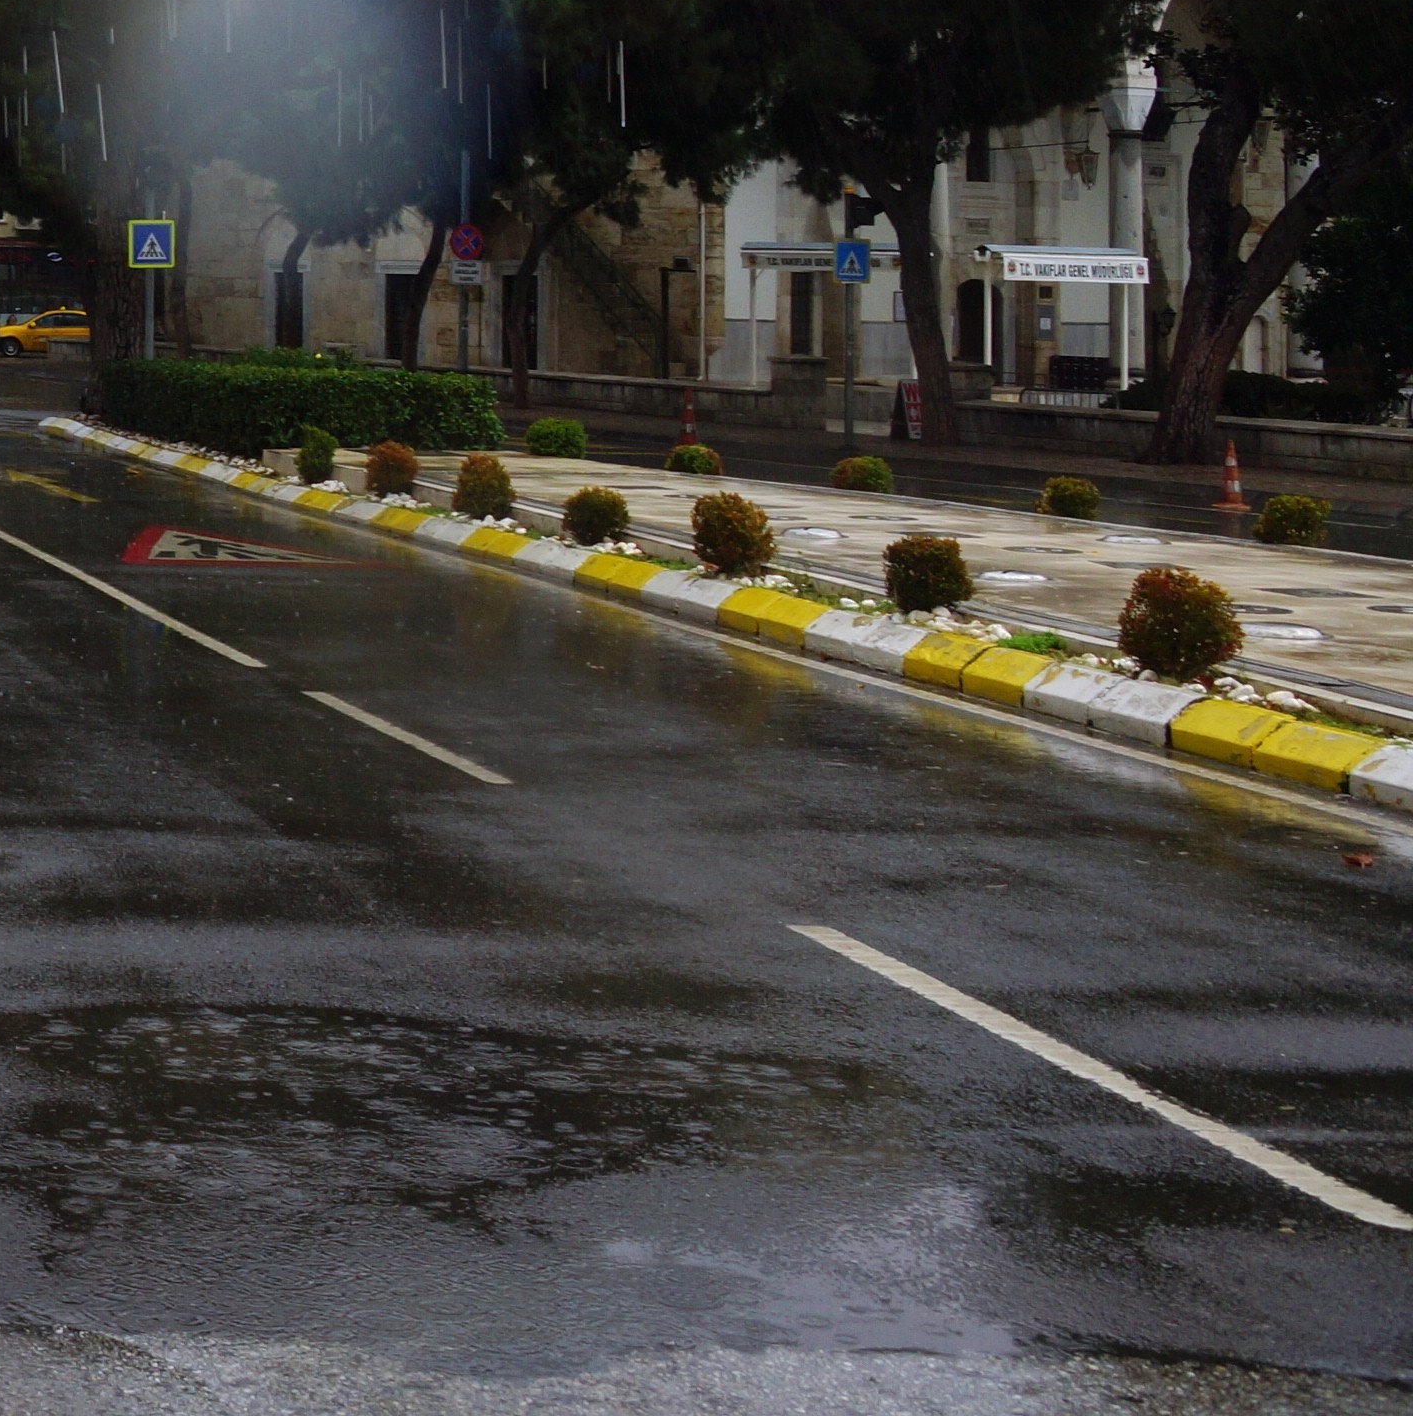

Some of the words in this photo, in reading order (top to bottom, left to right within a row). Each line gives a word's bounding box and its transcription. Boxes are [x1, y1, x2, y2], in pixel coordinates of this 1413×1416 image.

[814, 258, 833, 266] GENE
[1019, 263, 1032, 276] T.C.
[1034, 264, 1067, 277] VAKIFLAR
[1069, 265, 1090, 278] GENEL
[1091, 262, 1134, 279] MÜDÜRLÜĞÜ
